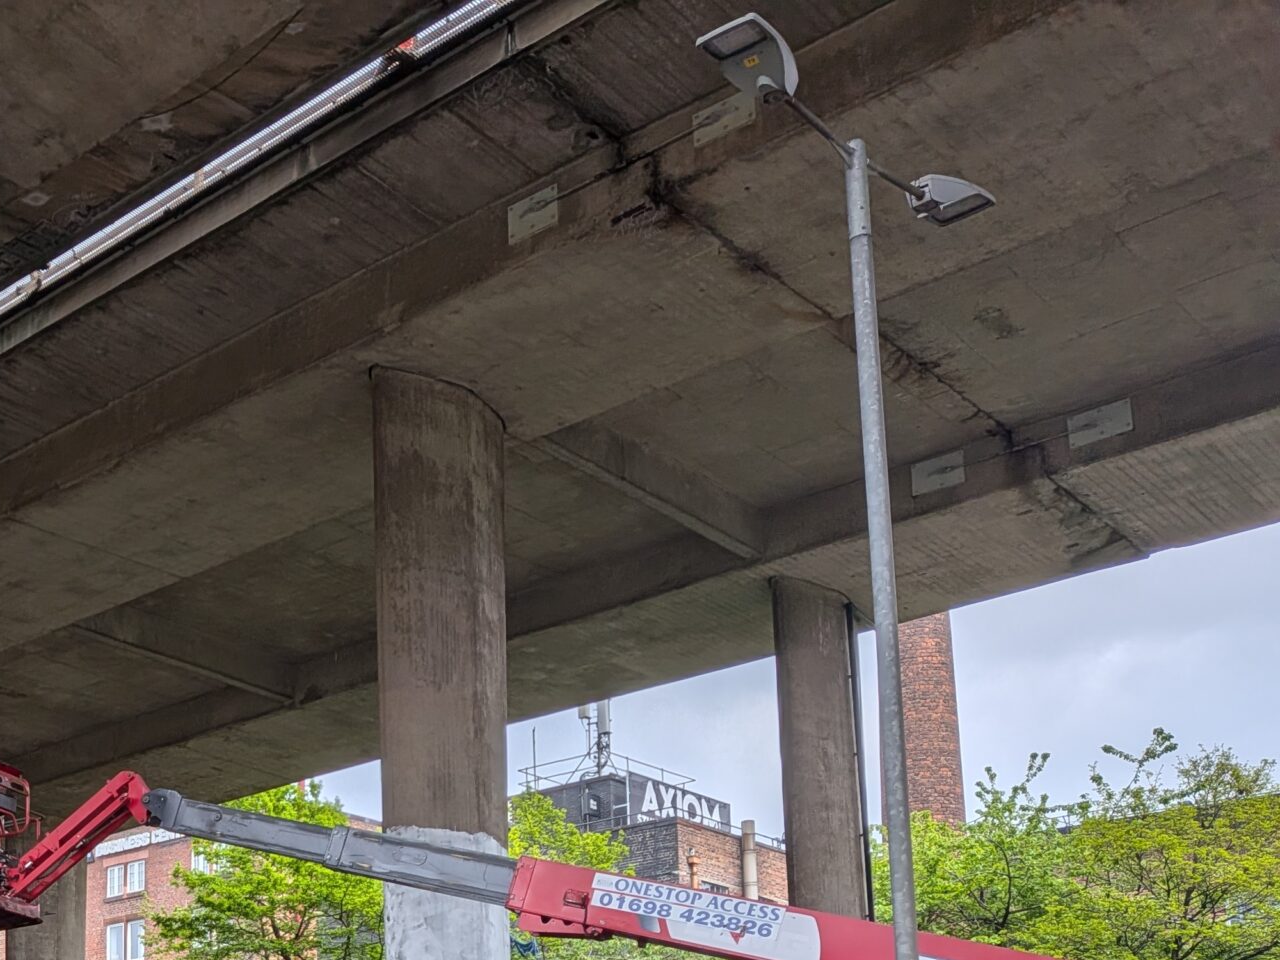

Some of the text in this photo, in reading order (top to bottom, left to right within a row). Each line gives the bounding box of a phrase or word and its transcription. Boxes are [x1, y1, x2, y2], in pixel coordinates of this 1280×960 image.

[641, 780, 720, 827] AXIOM
[599, 893, 773, 938] 01698 423826
[614, 879, 781, 921] ONESTOP ACCESS
